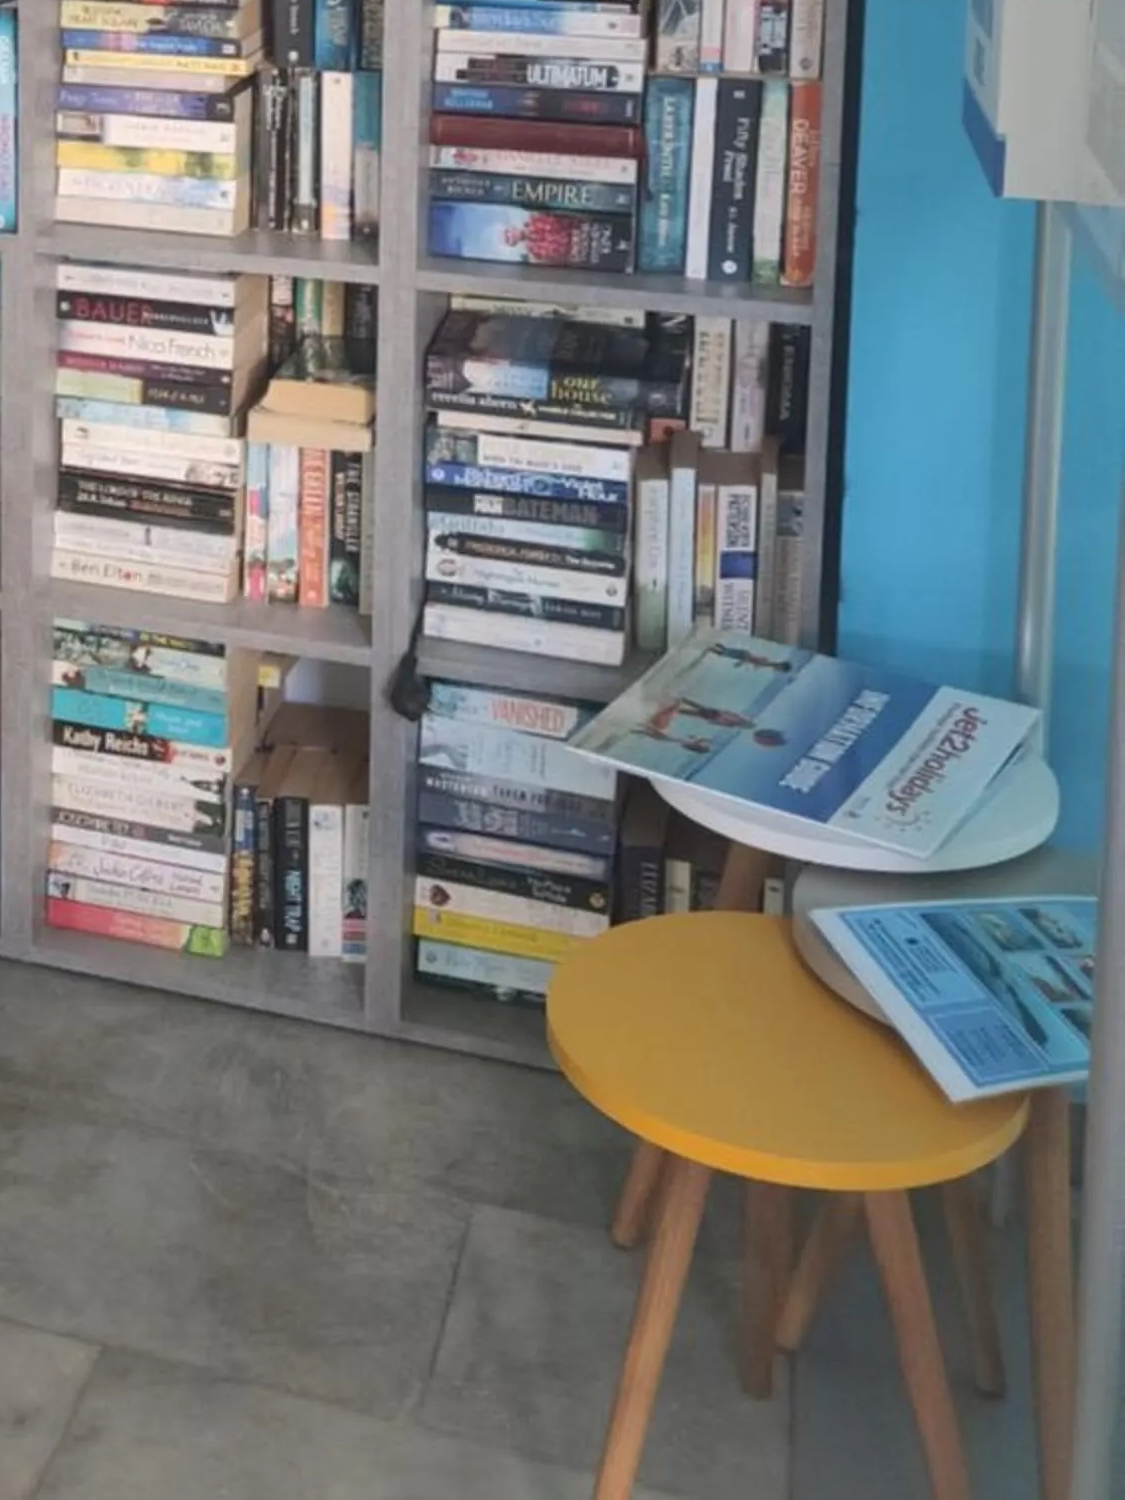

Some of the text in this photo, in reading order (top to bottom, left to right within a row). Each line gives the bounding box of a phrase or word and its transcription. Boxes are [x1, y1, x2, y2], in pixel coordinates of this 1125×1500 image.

[527, 64, 608, 88] ULTIMATUM
[734, 117, 751, 200] Fifty Shades
[790, 118, 810, 195] DEAVER
[511, 179, 592, 205] EMPIRE
[75, 298, 153, 324] BAUER
[552, 382, 613, 405] house
[563, 377, 600, 389] our
[502, 497, 599, 525] BATEMAN
[71, 559, 143, 583] Ben Elton
[489, 697, 565, 732] VANISHED
[63, 727, 148, 756] Kathy Reichs
[886, 706, 988, 817] Jet2holidays
